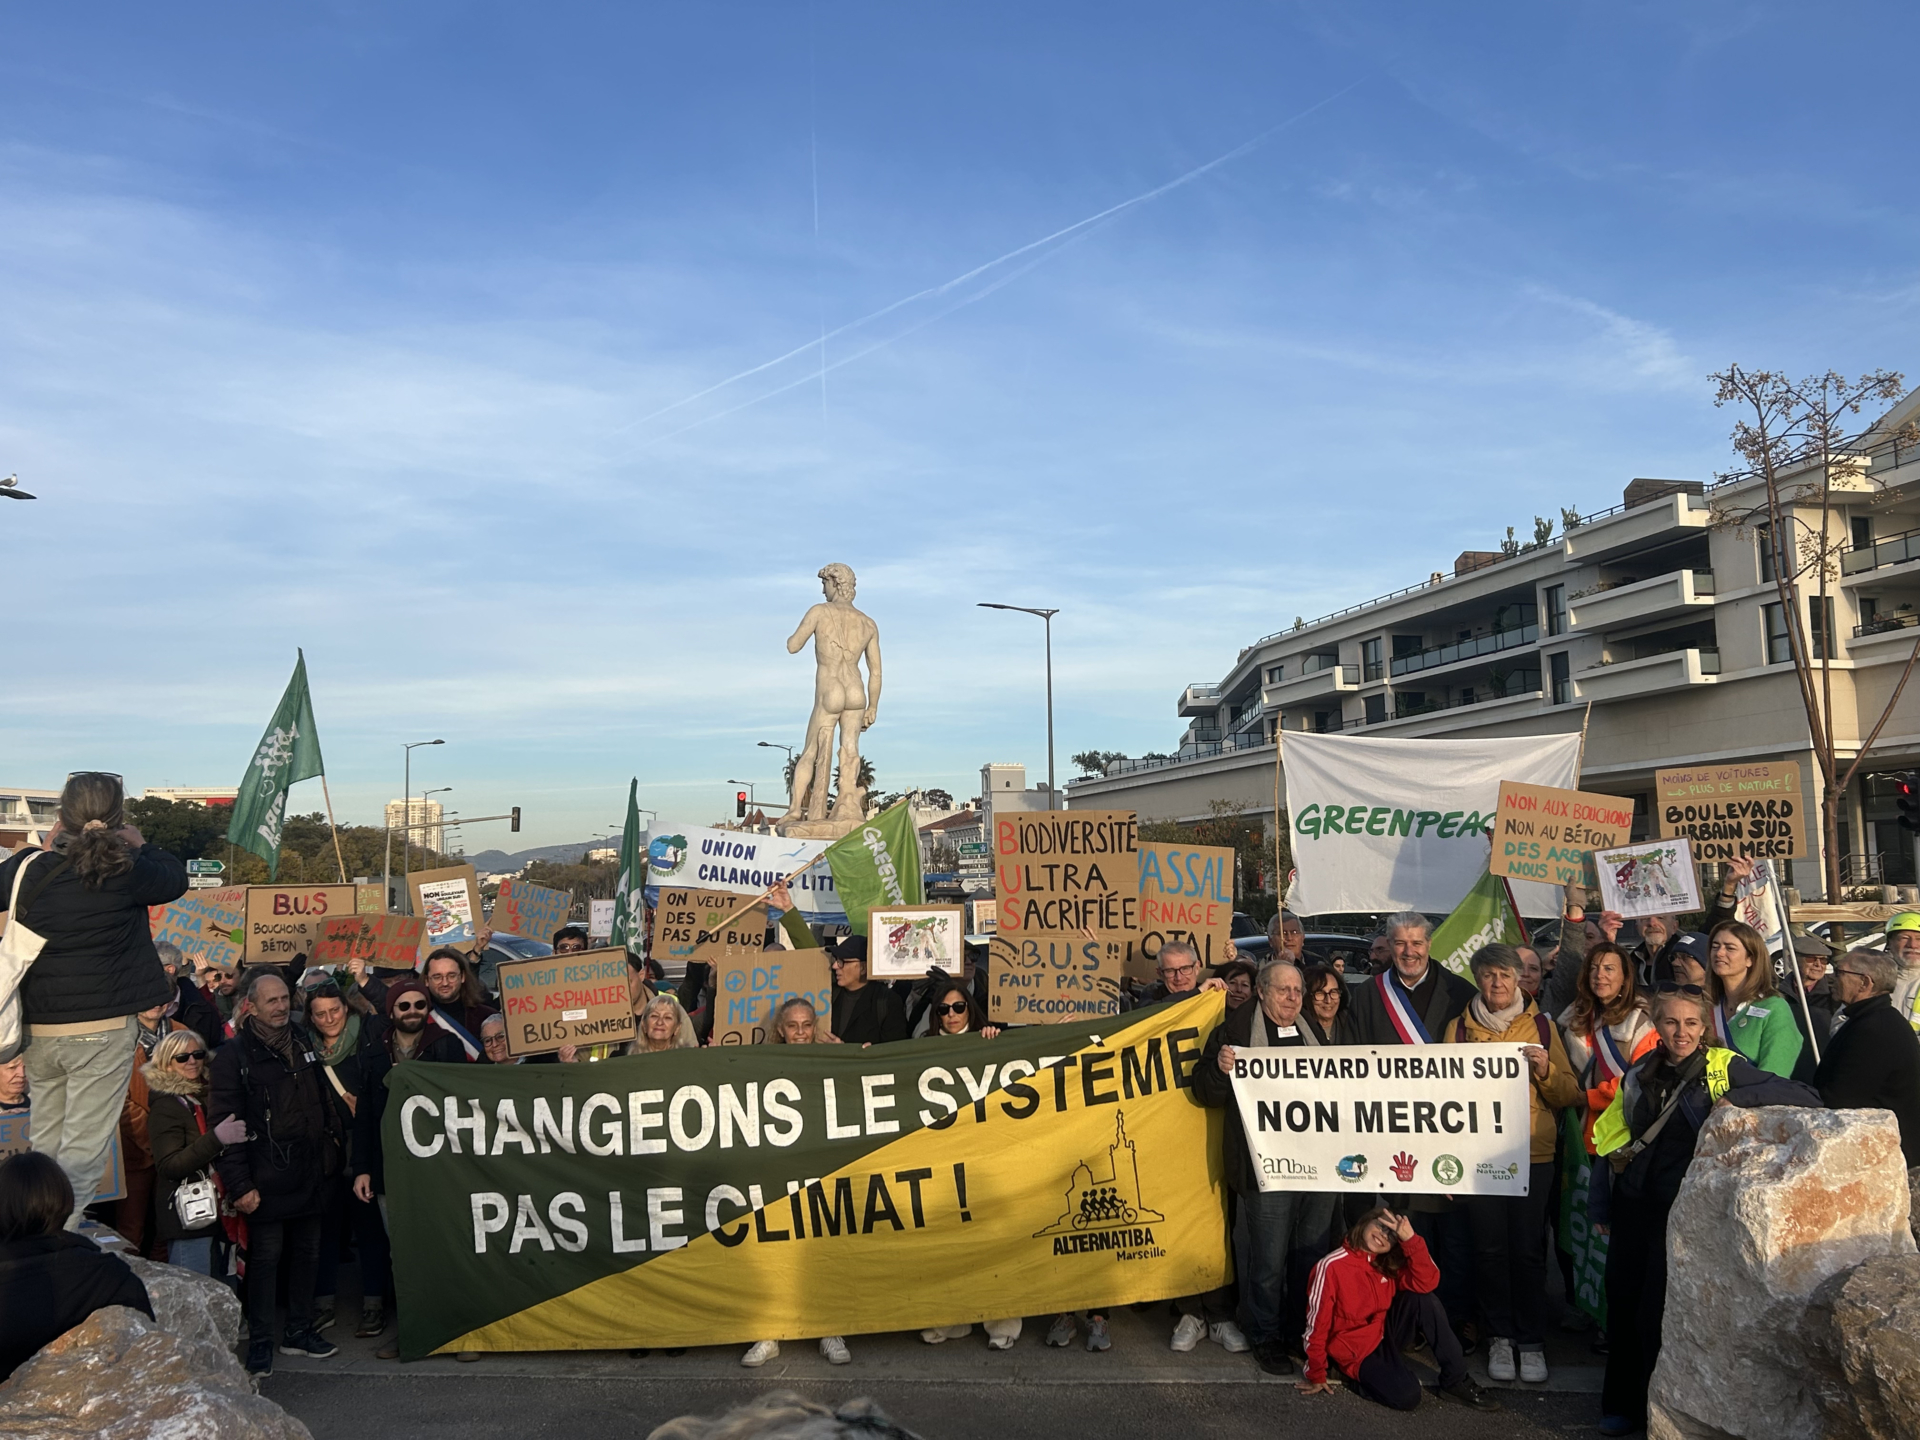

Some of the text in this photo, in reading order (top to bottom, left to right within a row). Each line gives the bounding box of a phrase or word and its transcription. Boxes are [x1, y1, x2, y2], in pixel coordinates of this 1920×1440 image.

[1689, 784, 1714, 795] PLUS
[1720, 783, 1733, 792] DE
[1738, 779, 1781, 791] NATURE
[1697, 772, 1710, 782] DE
[1505, 793, 1632, 828] NON AUX BOUCHONS
[1666, 799, 1793, 824] BOULEVARD
[1504, 819, 1616, 848] NON AU BÉTON
[1748, 819, 1792, 839] SUD
[701, 839, 757, 861] UNION
[1504, 841, 1540, 860] DES
[862, 827, 906, 905] GREENP
[1508, 861, 1548, 878] NOUS
[698, 863, 834, 892] CALANQUES LITT
[999, 863, 1109, 894] ULTRA
[273, 892, 328, 916] B.U.S
[499, 879, 570, 910] BUSINESS
[667, 892, 737, 908] ON VEUT
[253, 923, 307, 935] BOUCHONS
[325, 916, 363, 936] NON
[396, 918, 419, 937] LA
[509, 916, 554, 940] SALE
[666, 911, 739, 927] DES BUS
[261, 938, 296, 953] BÉTON
[662, 927, 691, 942] PAS
[1022, 940, 1100, 970] B.U.S
[505, 973, 525, 990] ON
[527, 968, 559, 986] VEUT
[751, 964, 783, 992] DE
[999, 973, 1094, 991] FAUT PAS
[507, 985, 629, 1016] PAS ASPHALTER
[574, 1022, 599, 1037] NON
[1235, 1057, 1520, 1079] BOULEVARD URBAIN SUD
[400, 1026, 1202, 1158] CHANGEONS LE SYSTÈME
[1257, 1101, 1503, 1134] NON MERCI !
[1257, 1153, 1318, 1174] anbus
[470, 1162, 972, 1254] PAS LE CLIMAT !
[1052, 1226, 1155, 1256] ALTERNATIBA
[1116, 1246, 1167, 1262] Marseille
